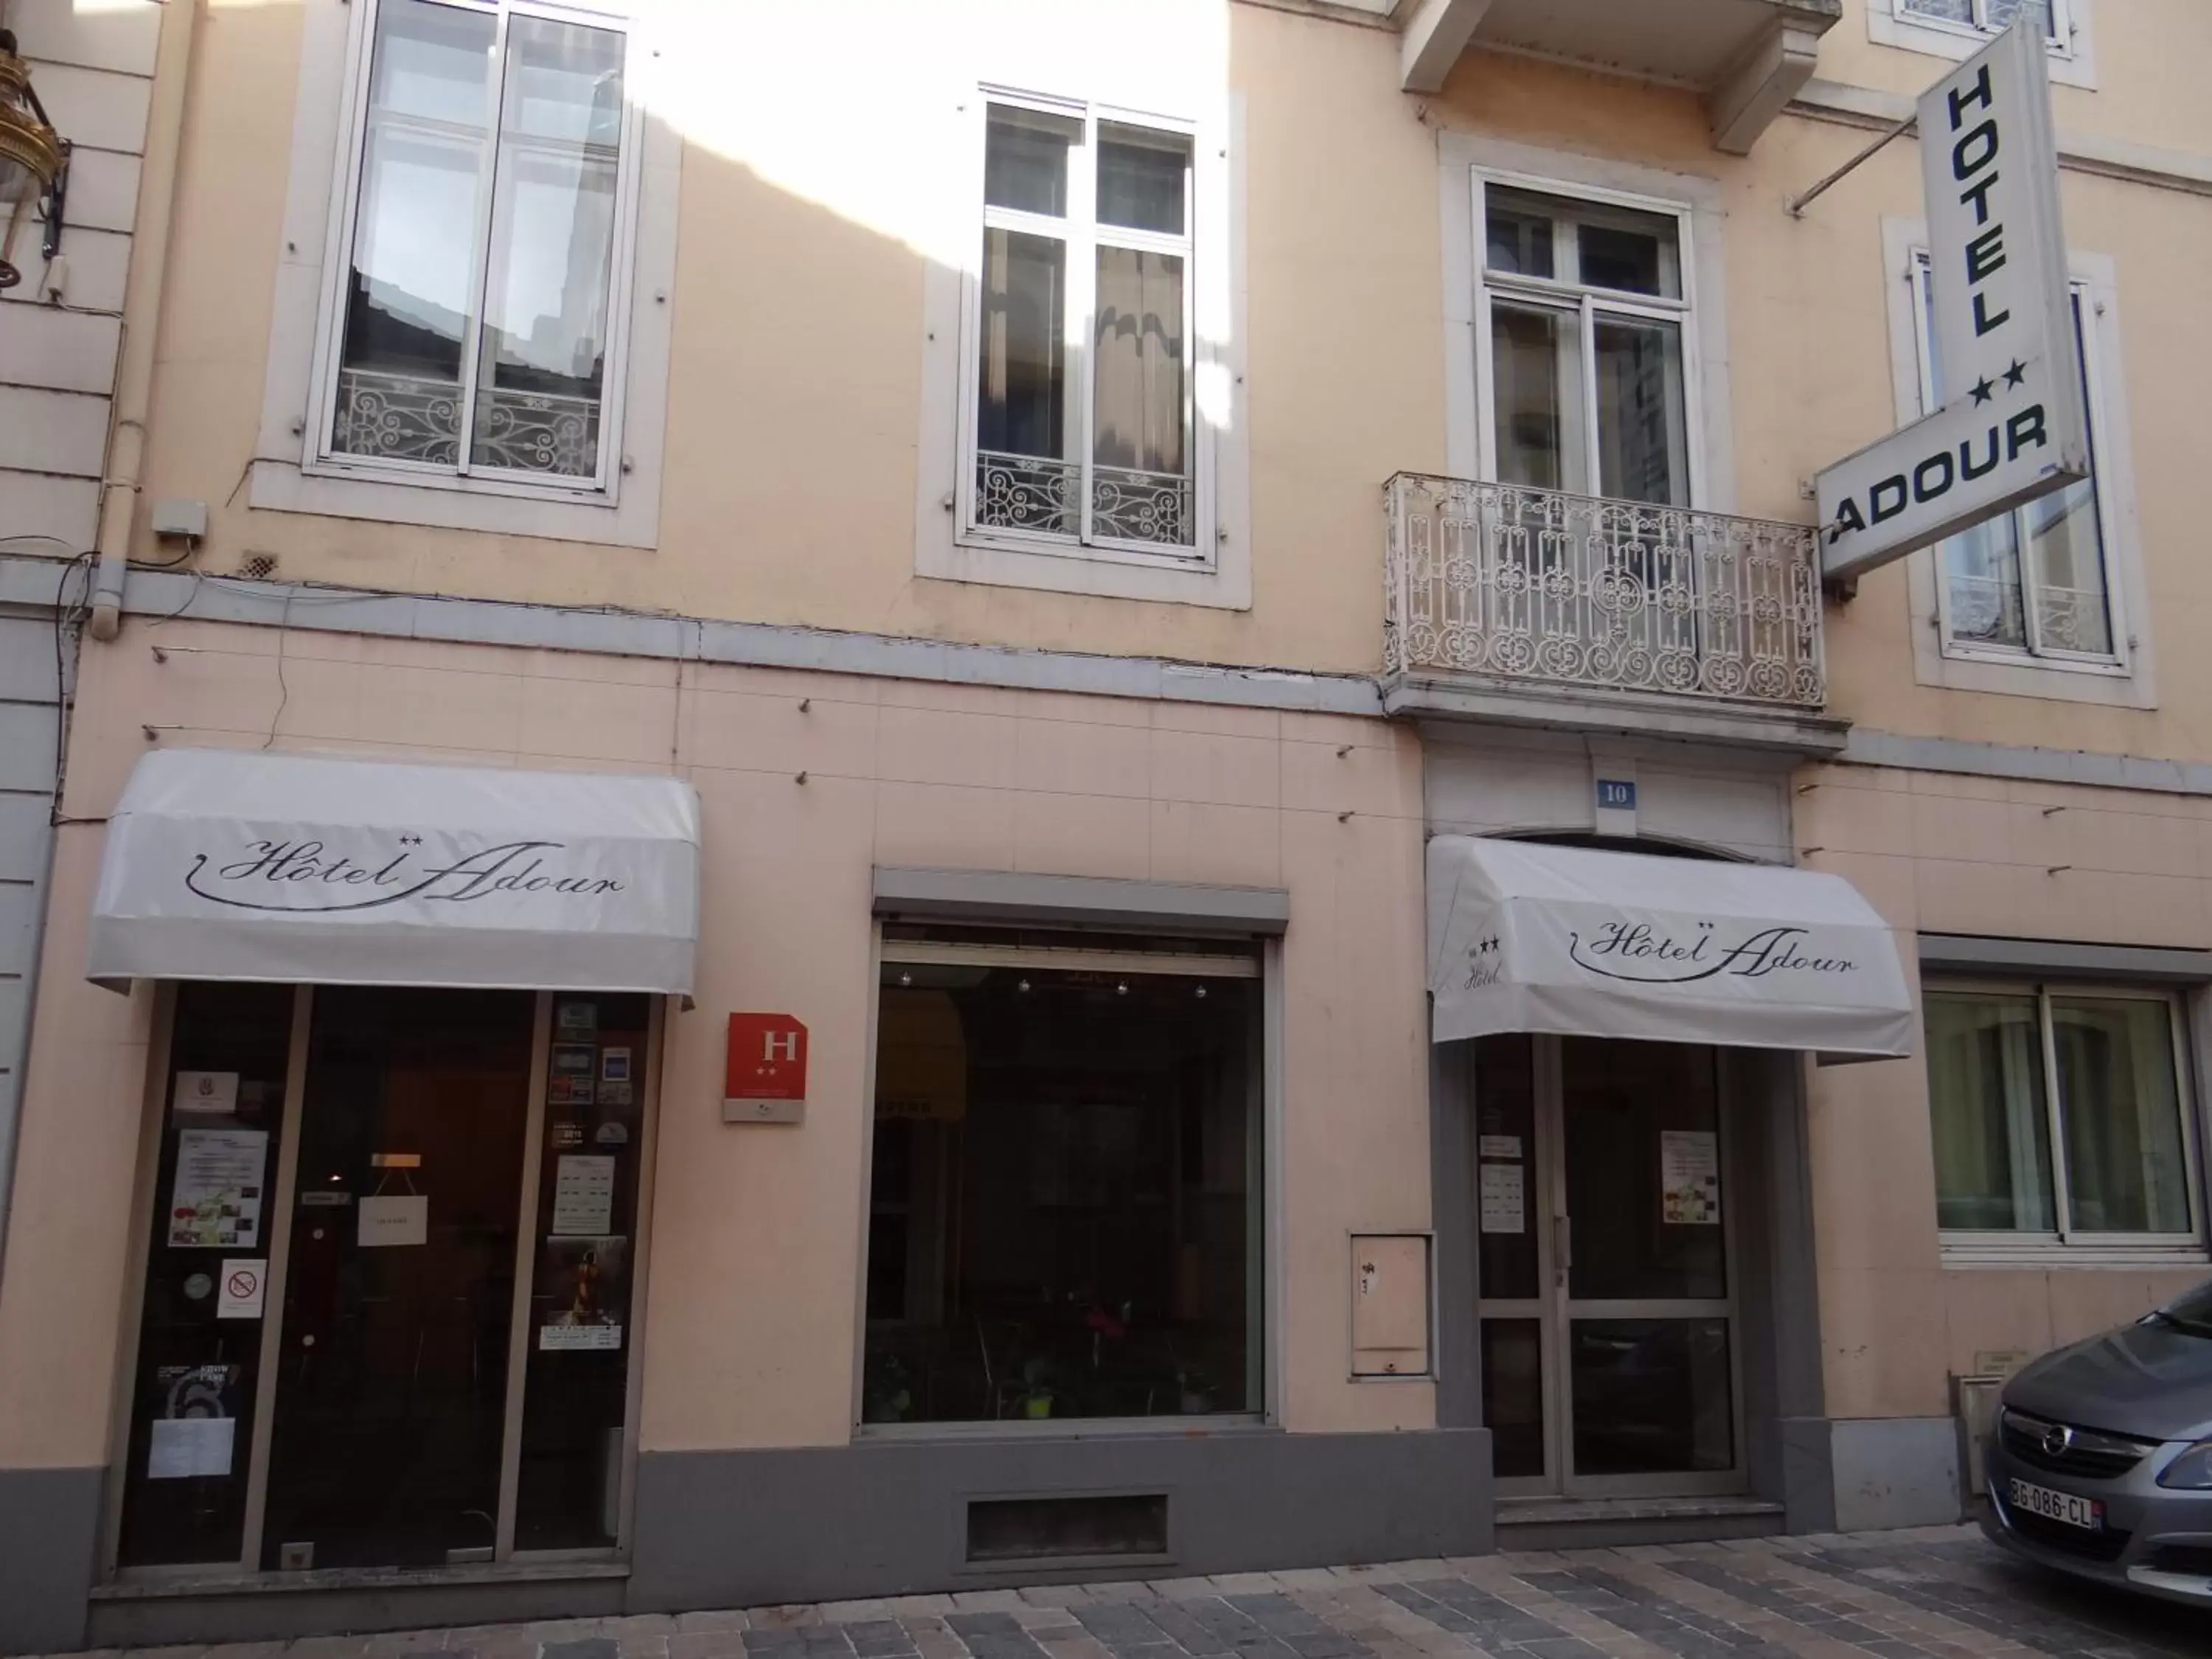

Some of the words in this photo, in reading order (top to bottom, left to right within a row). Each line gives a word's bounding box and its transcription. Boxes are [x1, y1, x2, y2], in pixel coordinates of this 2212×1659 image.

[1947, 63, 2010, 337] HOTEL
[1828, 403, 2048, 545] ADOUR
[1606, 784, 1627, 804] 10
[220, 839, 410, 886] Hôtel
[422, 841, 625, 902] Adour
[1589, 922, 1710, 962] Hôtel
[1722, 927, 1860, 977] Adour
[764, 1031, 797, 1061] H
